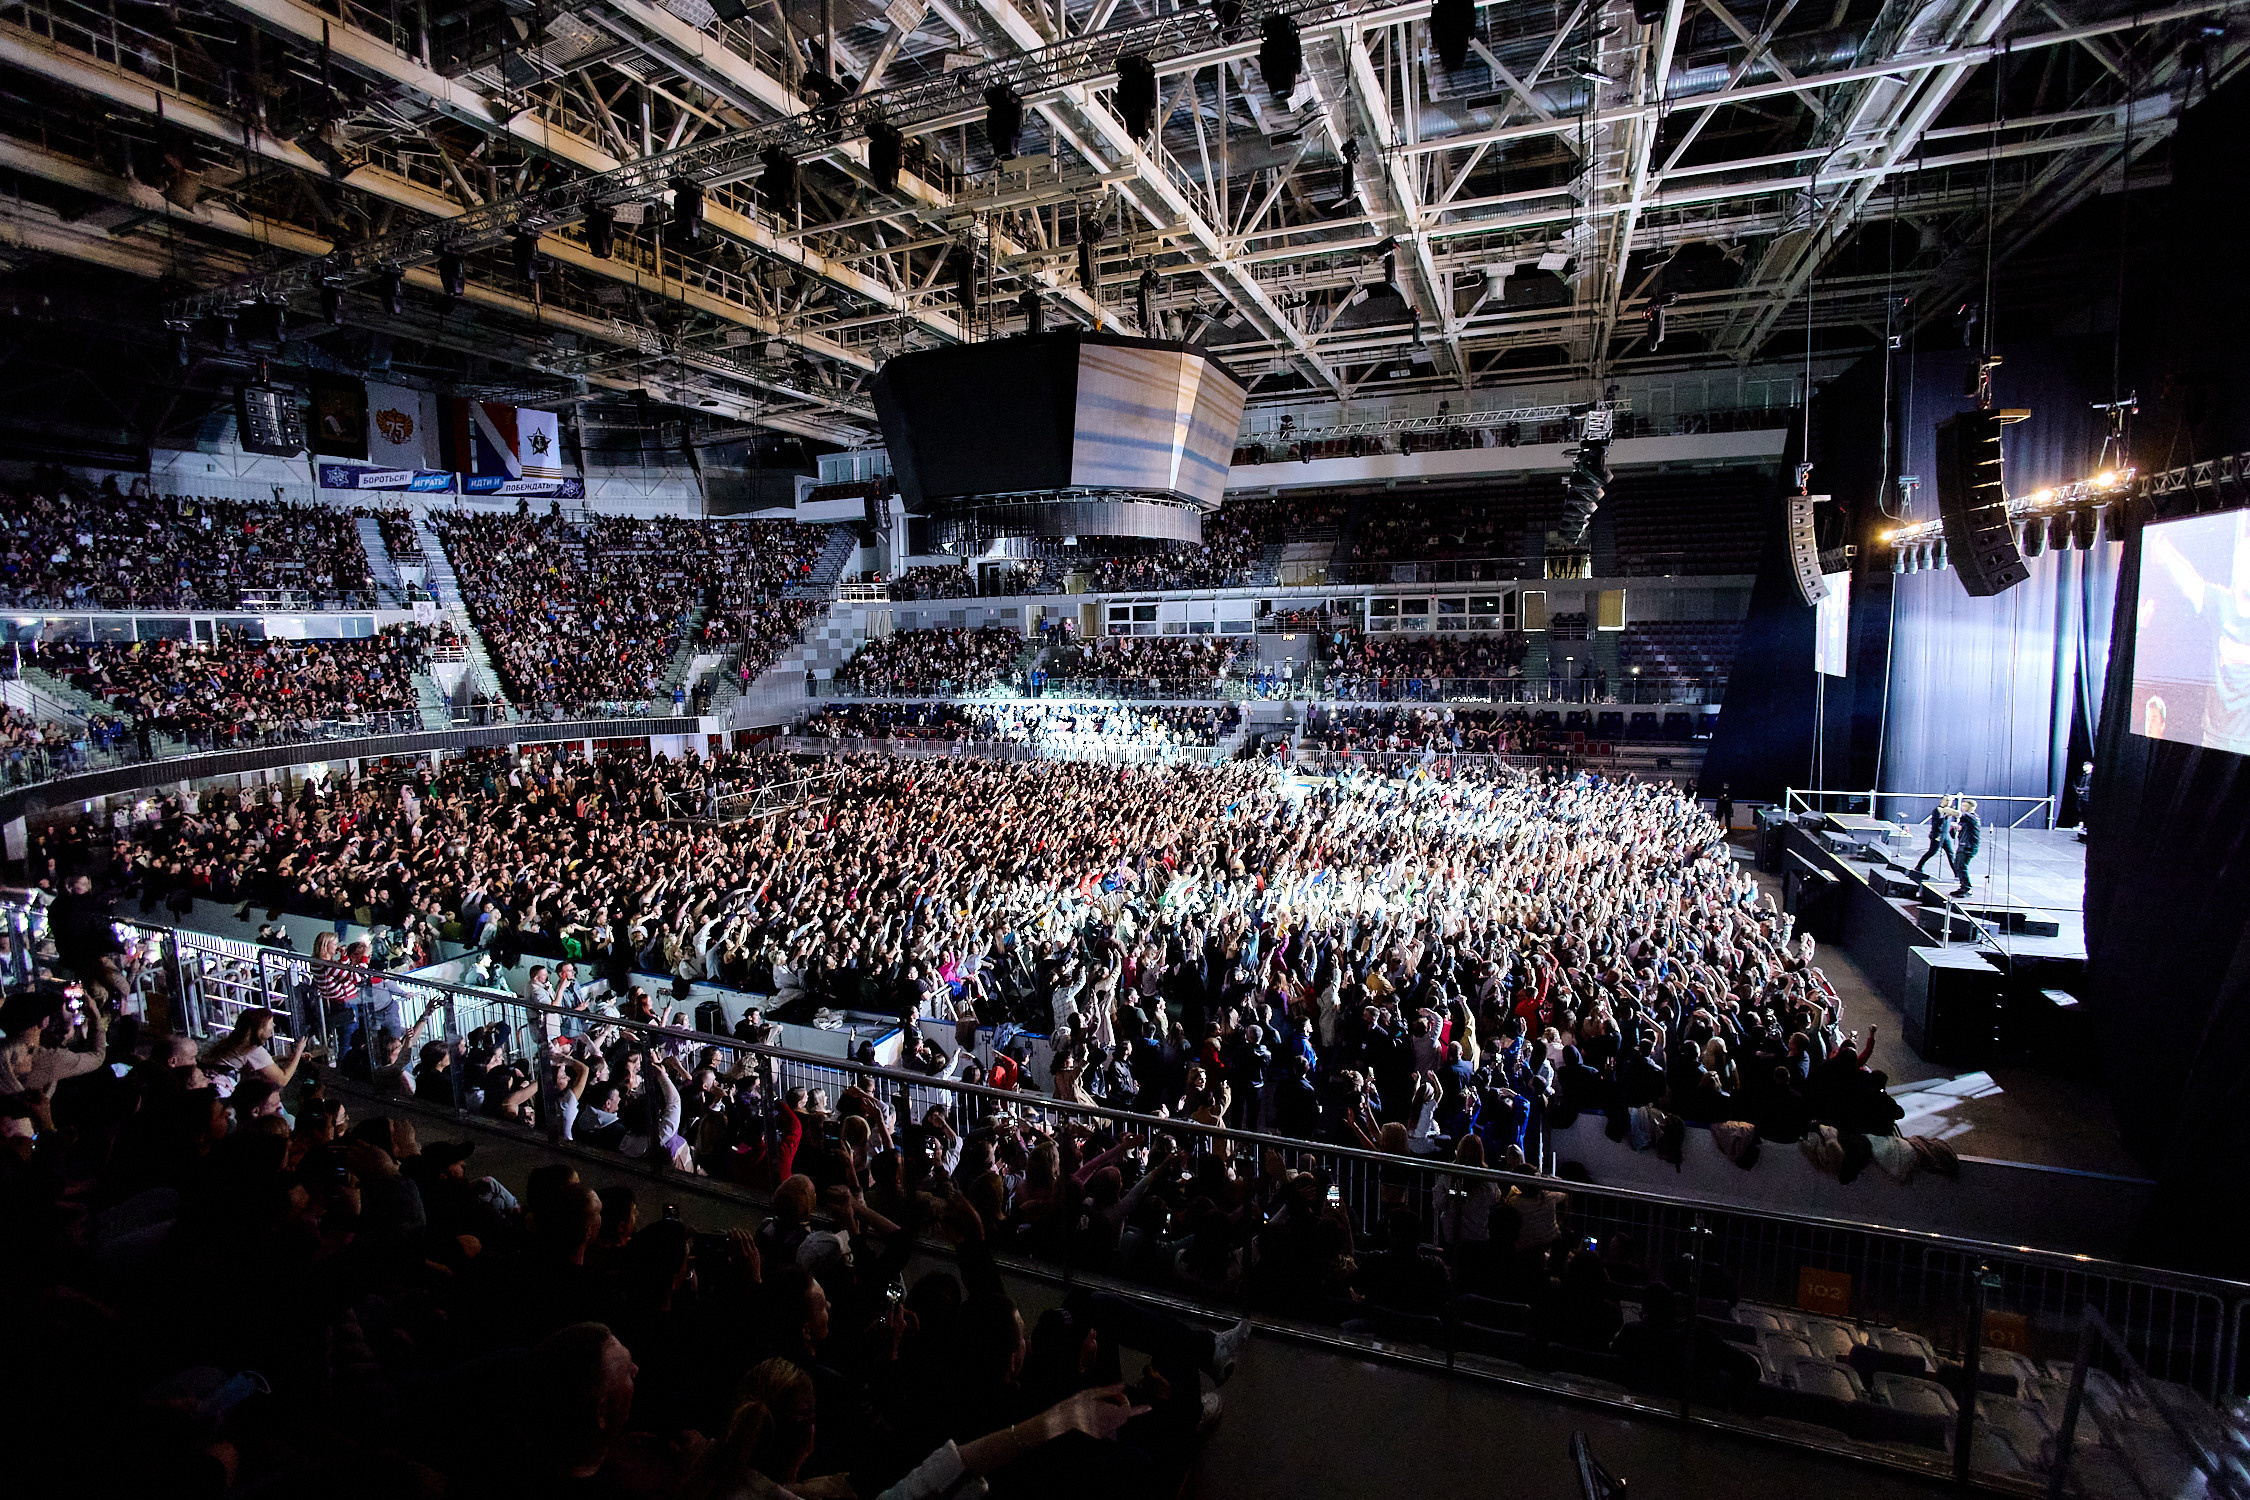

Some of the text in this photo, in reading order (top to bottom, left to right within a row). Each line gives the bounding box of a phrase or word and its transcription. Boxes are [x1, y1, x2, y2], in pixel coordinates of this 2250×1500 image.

[386, 421, 405, 438] 75
[363, 474, 408, 484] БОРОТЬСЯ!
[414, 478, 446, 488] ИГРАТЬ!
[471, 479, 492, 487] ИДТИ
[1807, 1282, 1842, 1300] 102
